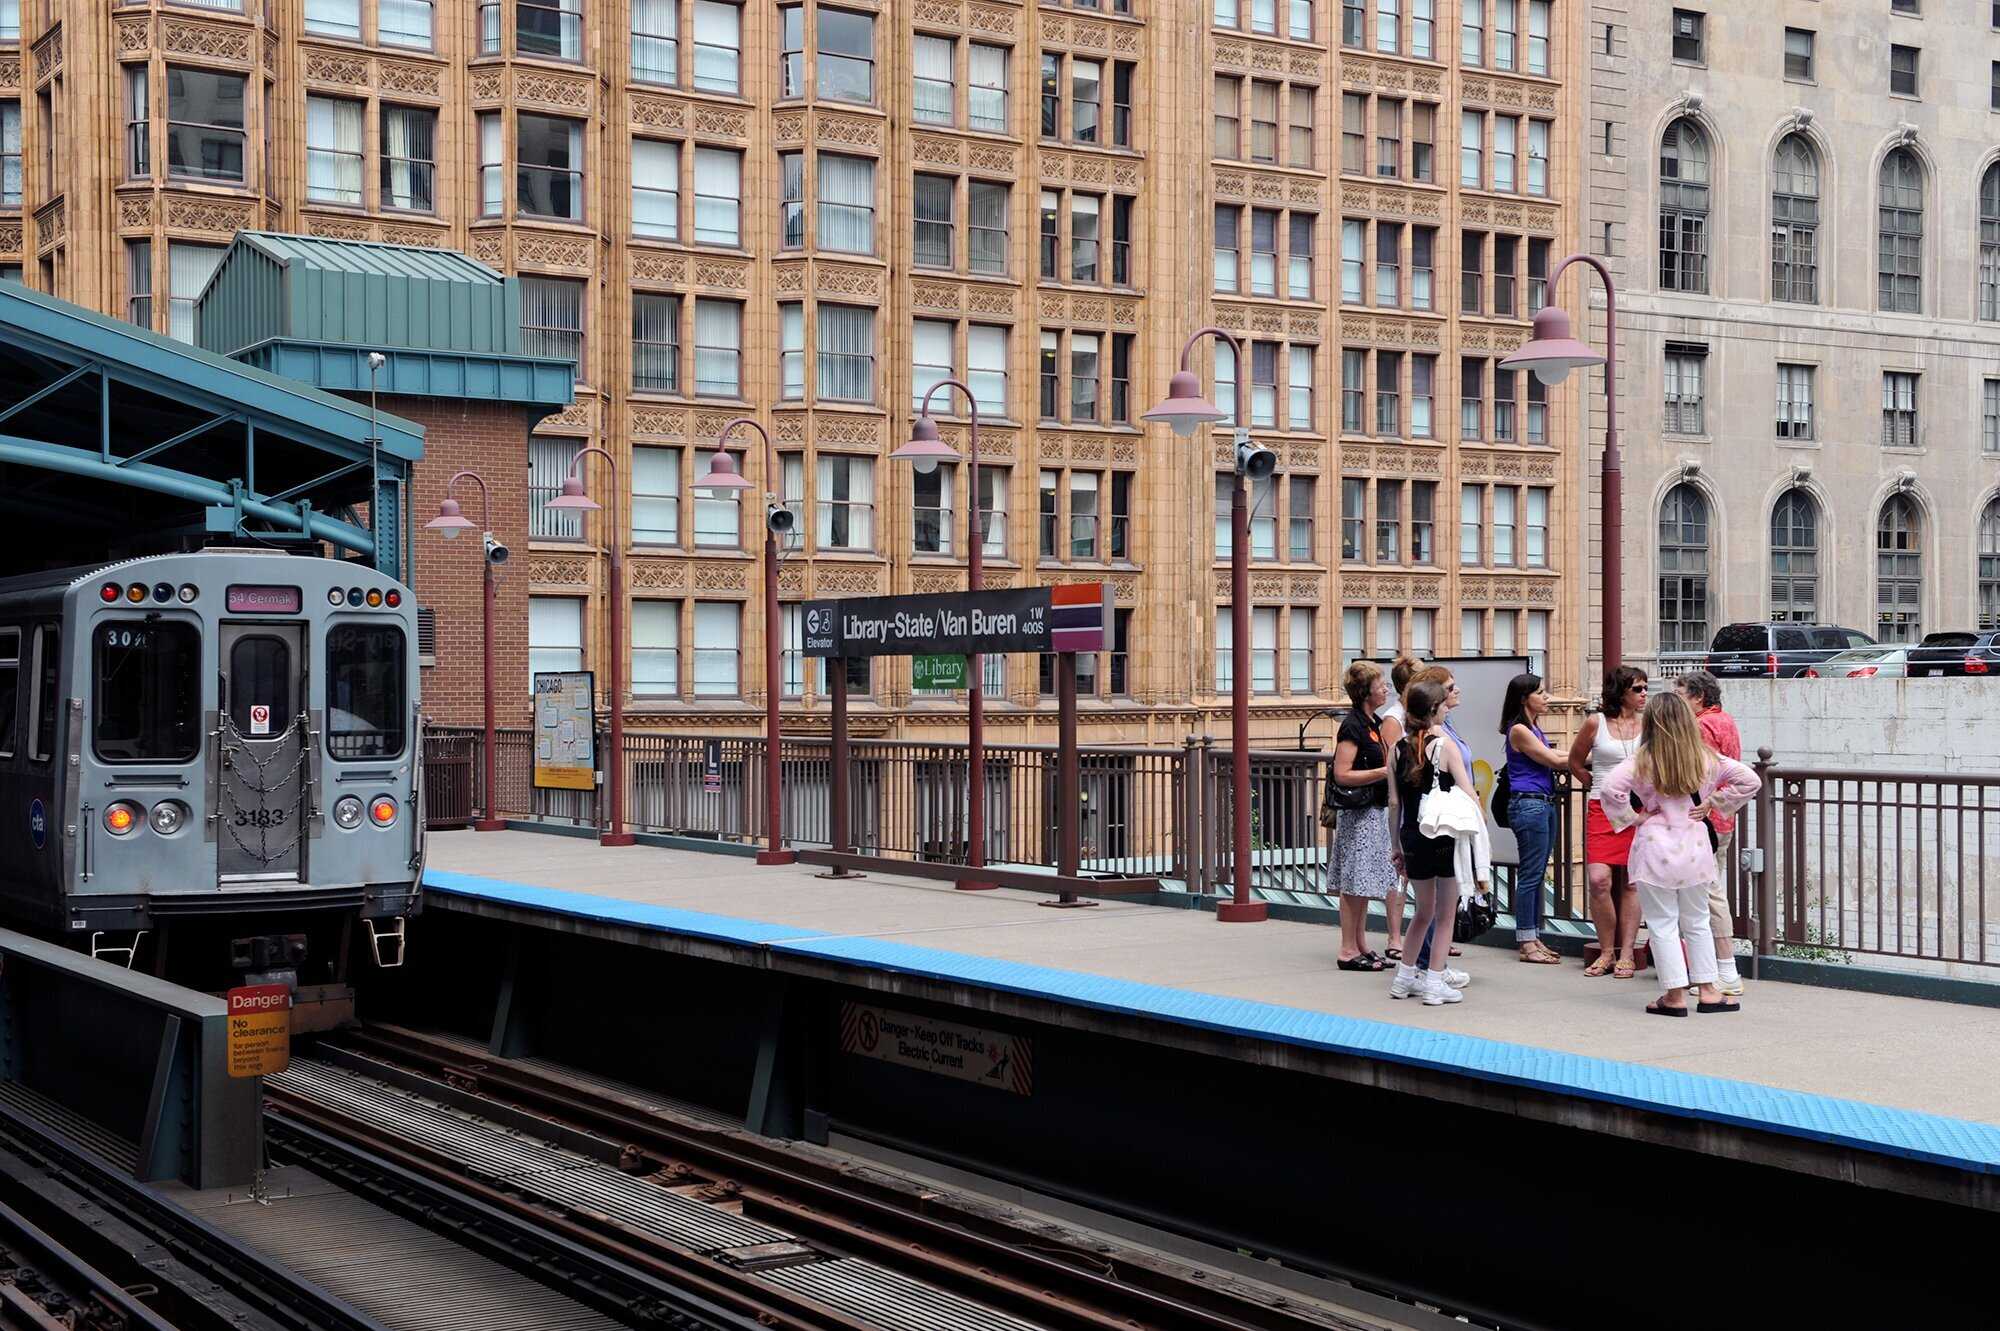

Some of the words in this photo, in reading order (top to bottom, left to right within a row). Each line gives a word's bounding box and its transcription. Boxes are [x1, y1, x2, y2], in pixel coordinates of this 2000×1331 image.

[230, 592, 244, 604] 54
[1029, 607, 1044, 620] 1W
[971, 608, 1017, 636] Buren
[1022, 621, 1044, 635] 400S
[807, 636, 833, 649] Elevator
[924, 657, 964, 680] Library
[536, 678, 563, 694] CHICAGO
[32, 813, 44, 832] cta
[235, 809, 283, 827] 3183
[232, 993, 286, 1009] Danger
[233, 1019, 248, 1029] No
[233, 1026, 286, 1039] clearance
[940, 1030, 953, 1047] Off
[955, 1034, 985, 1054] Tracks
[898, 1041, 930, 1062] Electric
[931, 1049, 964, 1068] Current
